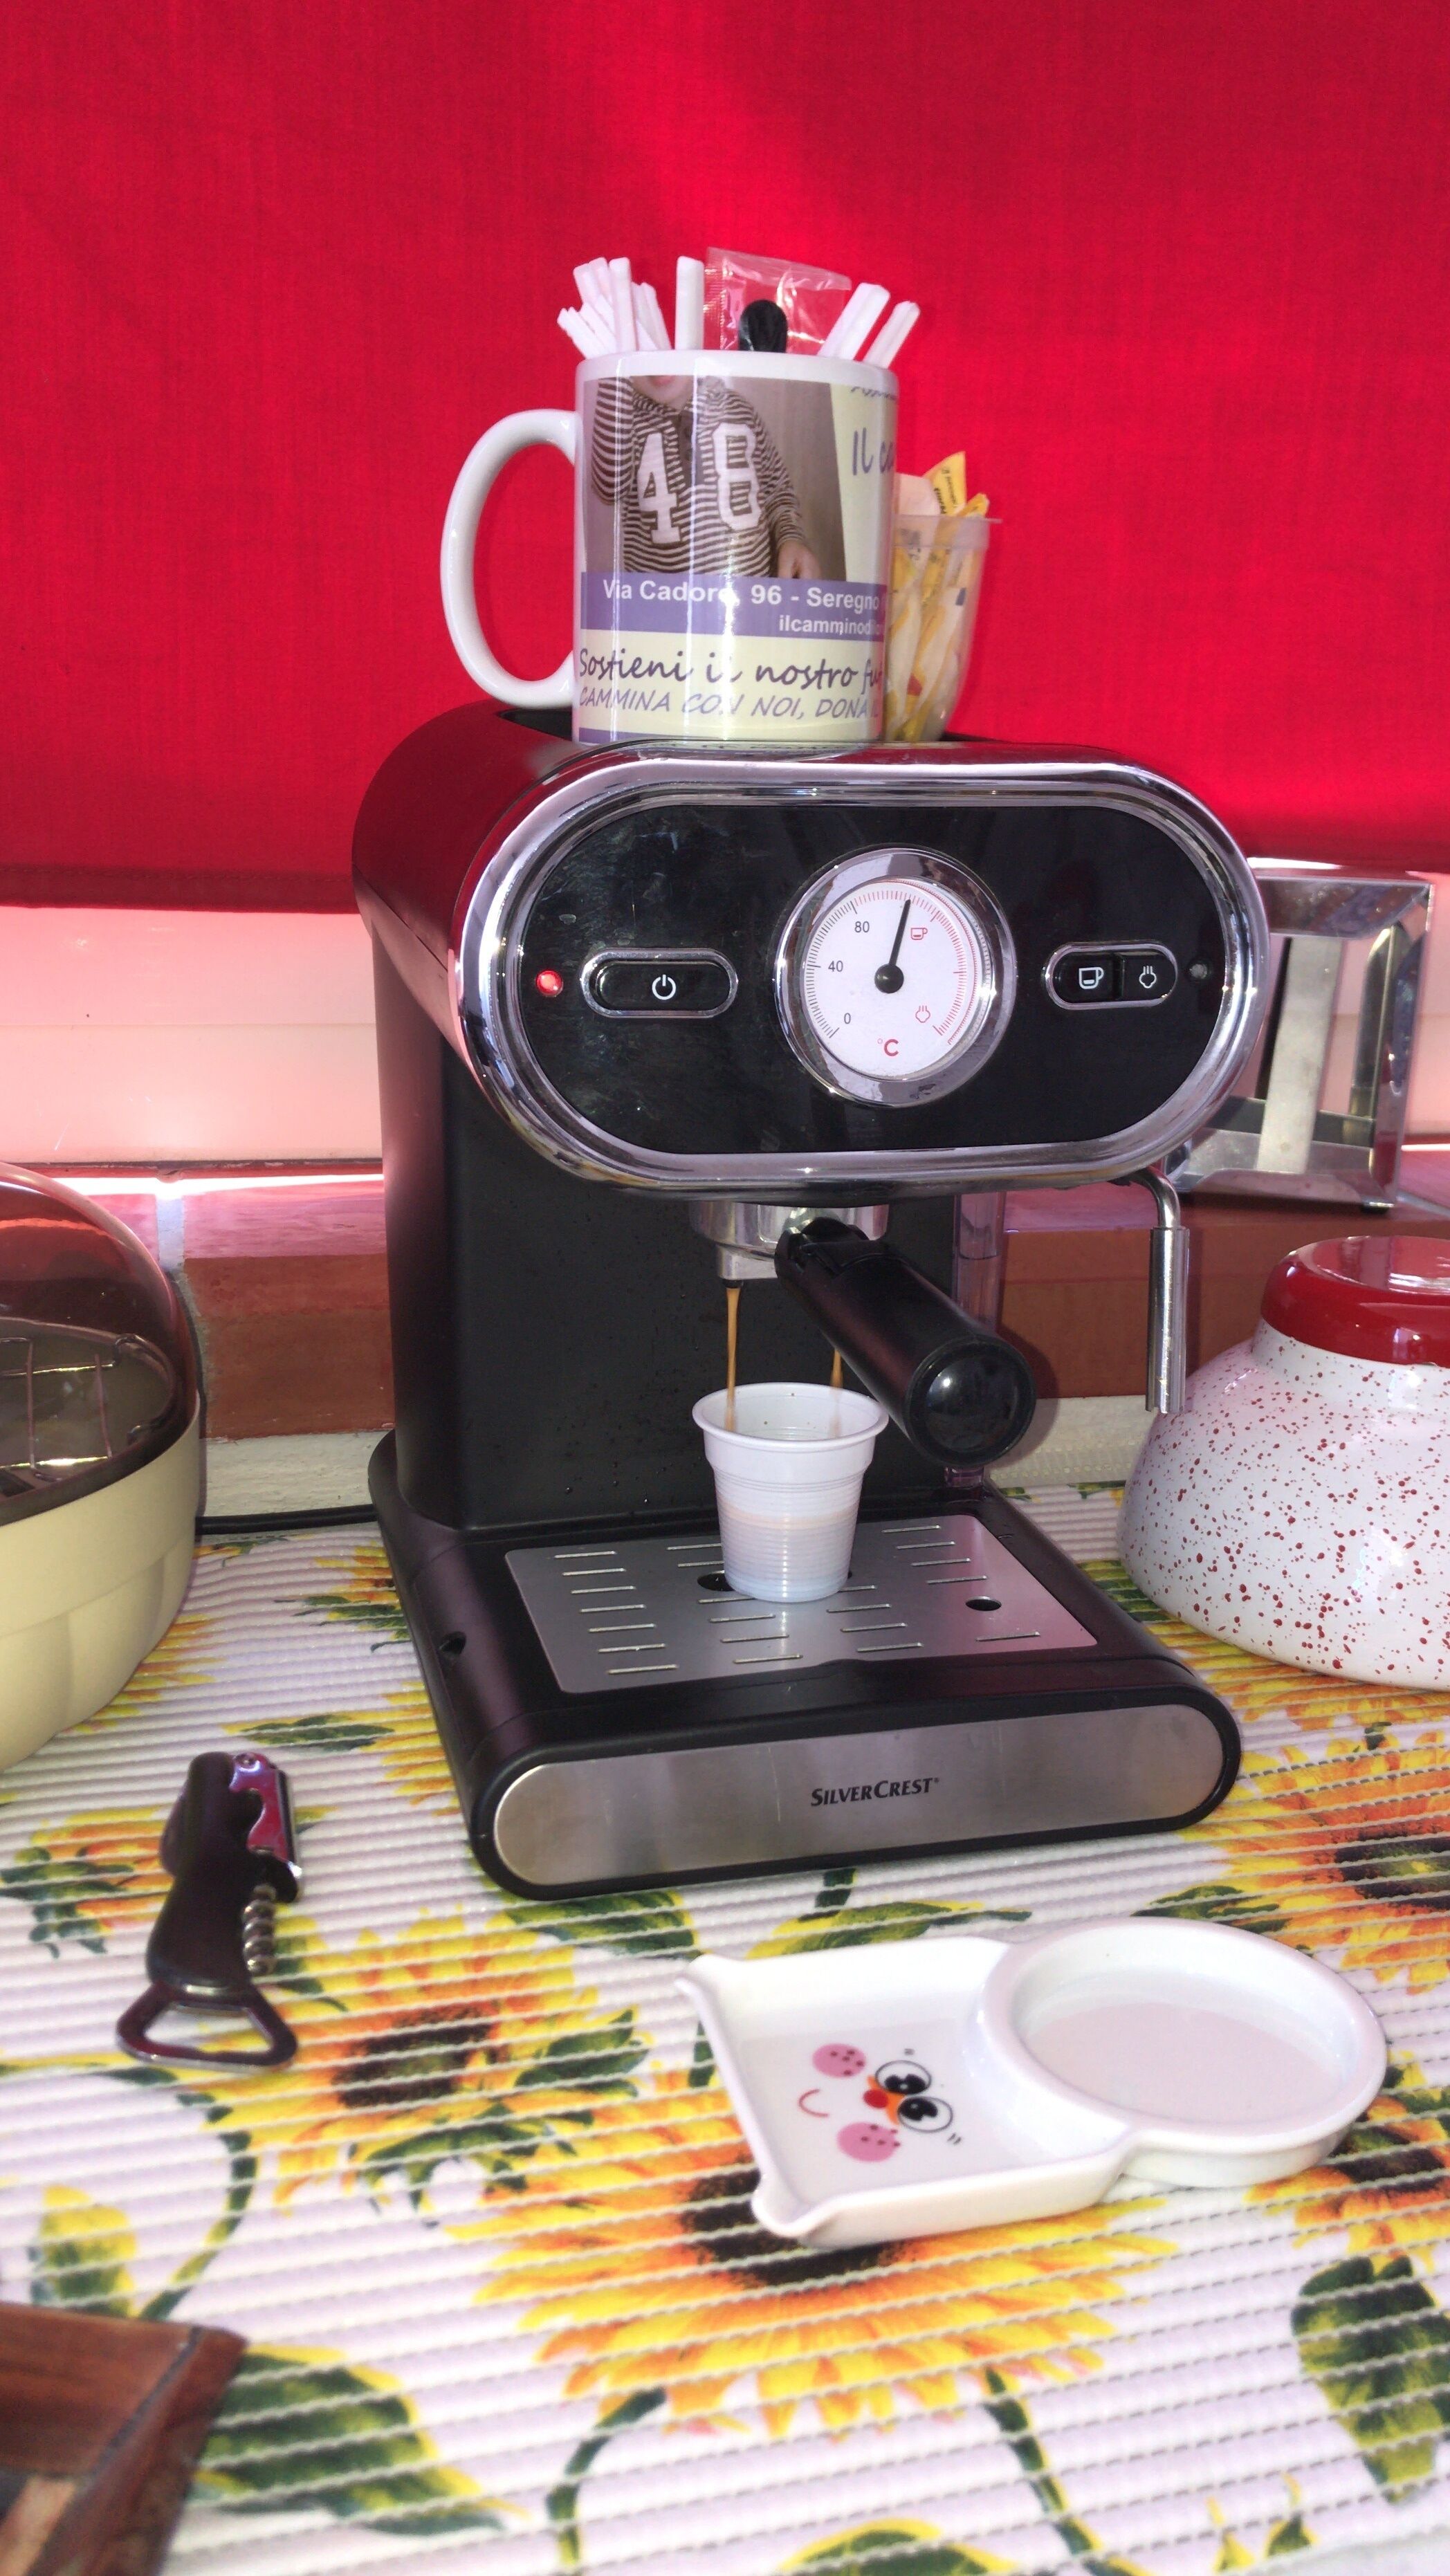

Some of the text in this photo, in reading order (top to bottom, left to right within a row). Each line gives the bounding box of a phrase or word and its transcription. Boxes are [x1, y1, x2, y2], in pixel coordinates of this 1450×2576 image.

[852, 427, 874, 476] Il
[603, 579, 632, 600] Via
[751, 584, 782, 605] 96
[806, 587, 881, 614] Seregno
[579, 647, 695, 681] Sostieni
[755, 658, 859, 690] nostro
[579, 686, 670, 712] CAMMINA
[751, 694, 805, 720] NOI,
[854, 921, 870, 933] 80
[827, 959, 844, 973] 40
[843, 1012, 852, 1024] 0
